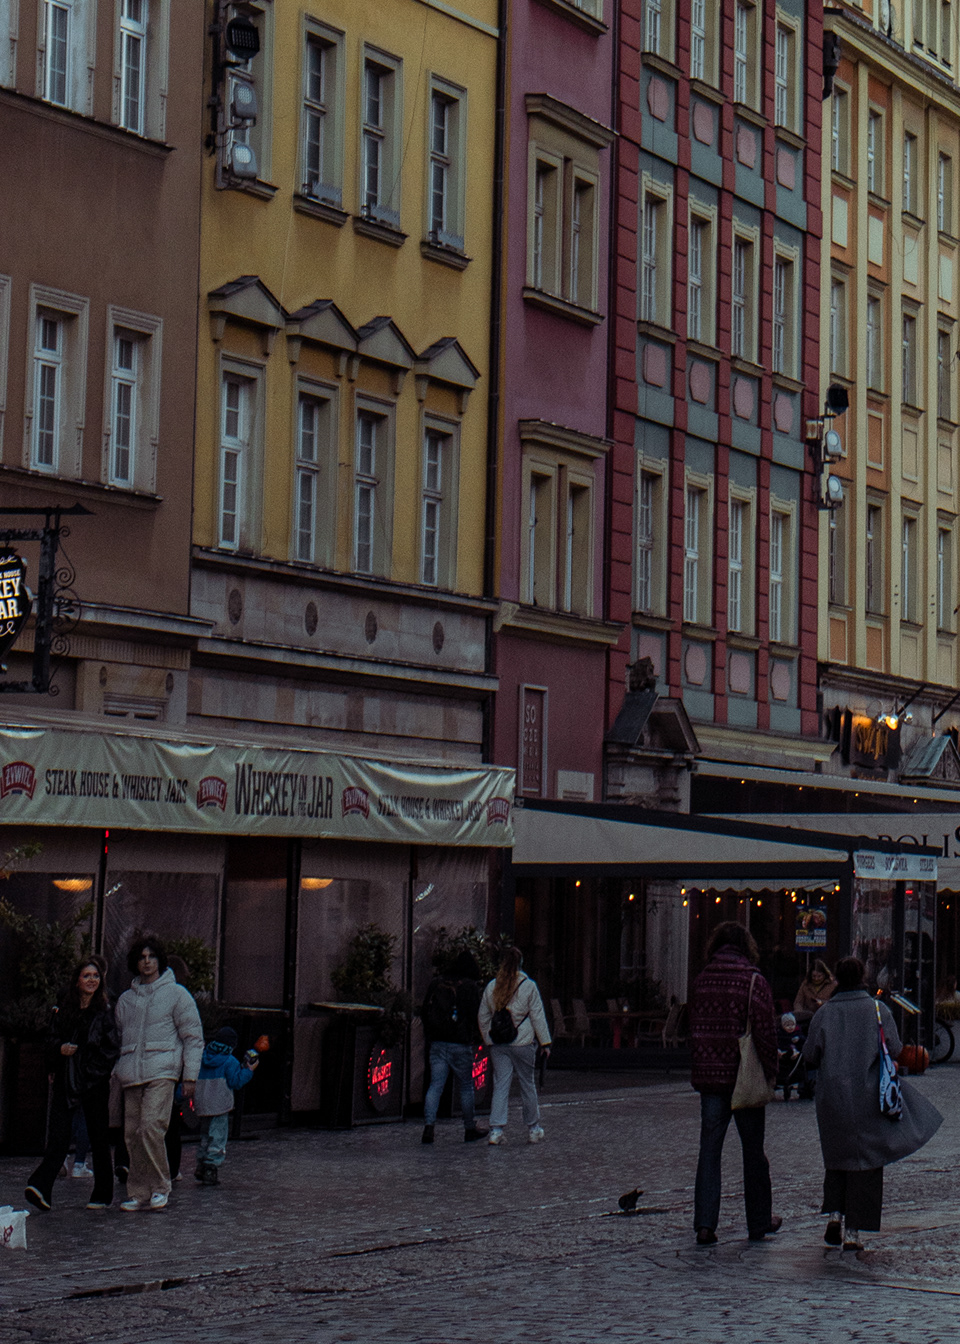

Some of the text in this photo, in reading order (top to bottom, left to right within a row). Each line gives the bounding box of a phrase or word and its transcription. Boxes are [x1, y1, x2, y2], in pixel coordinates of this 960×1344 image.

[45, 769, 188, 804] STEAK HOUSE & WHISKEY JARS
[307, 775, 334, 819] JAR
[400, 795, 425, 820] HOUSE
